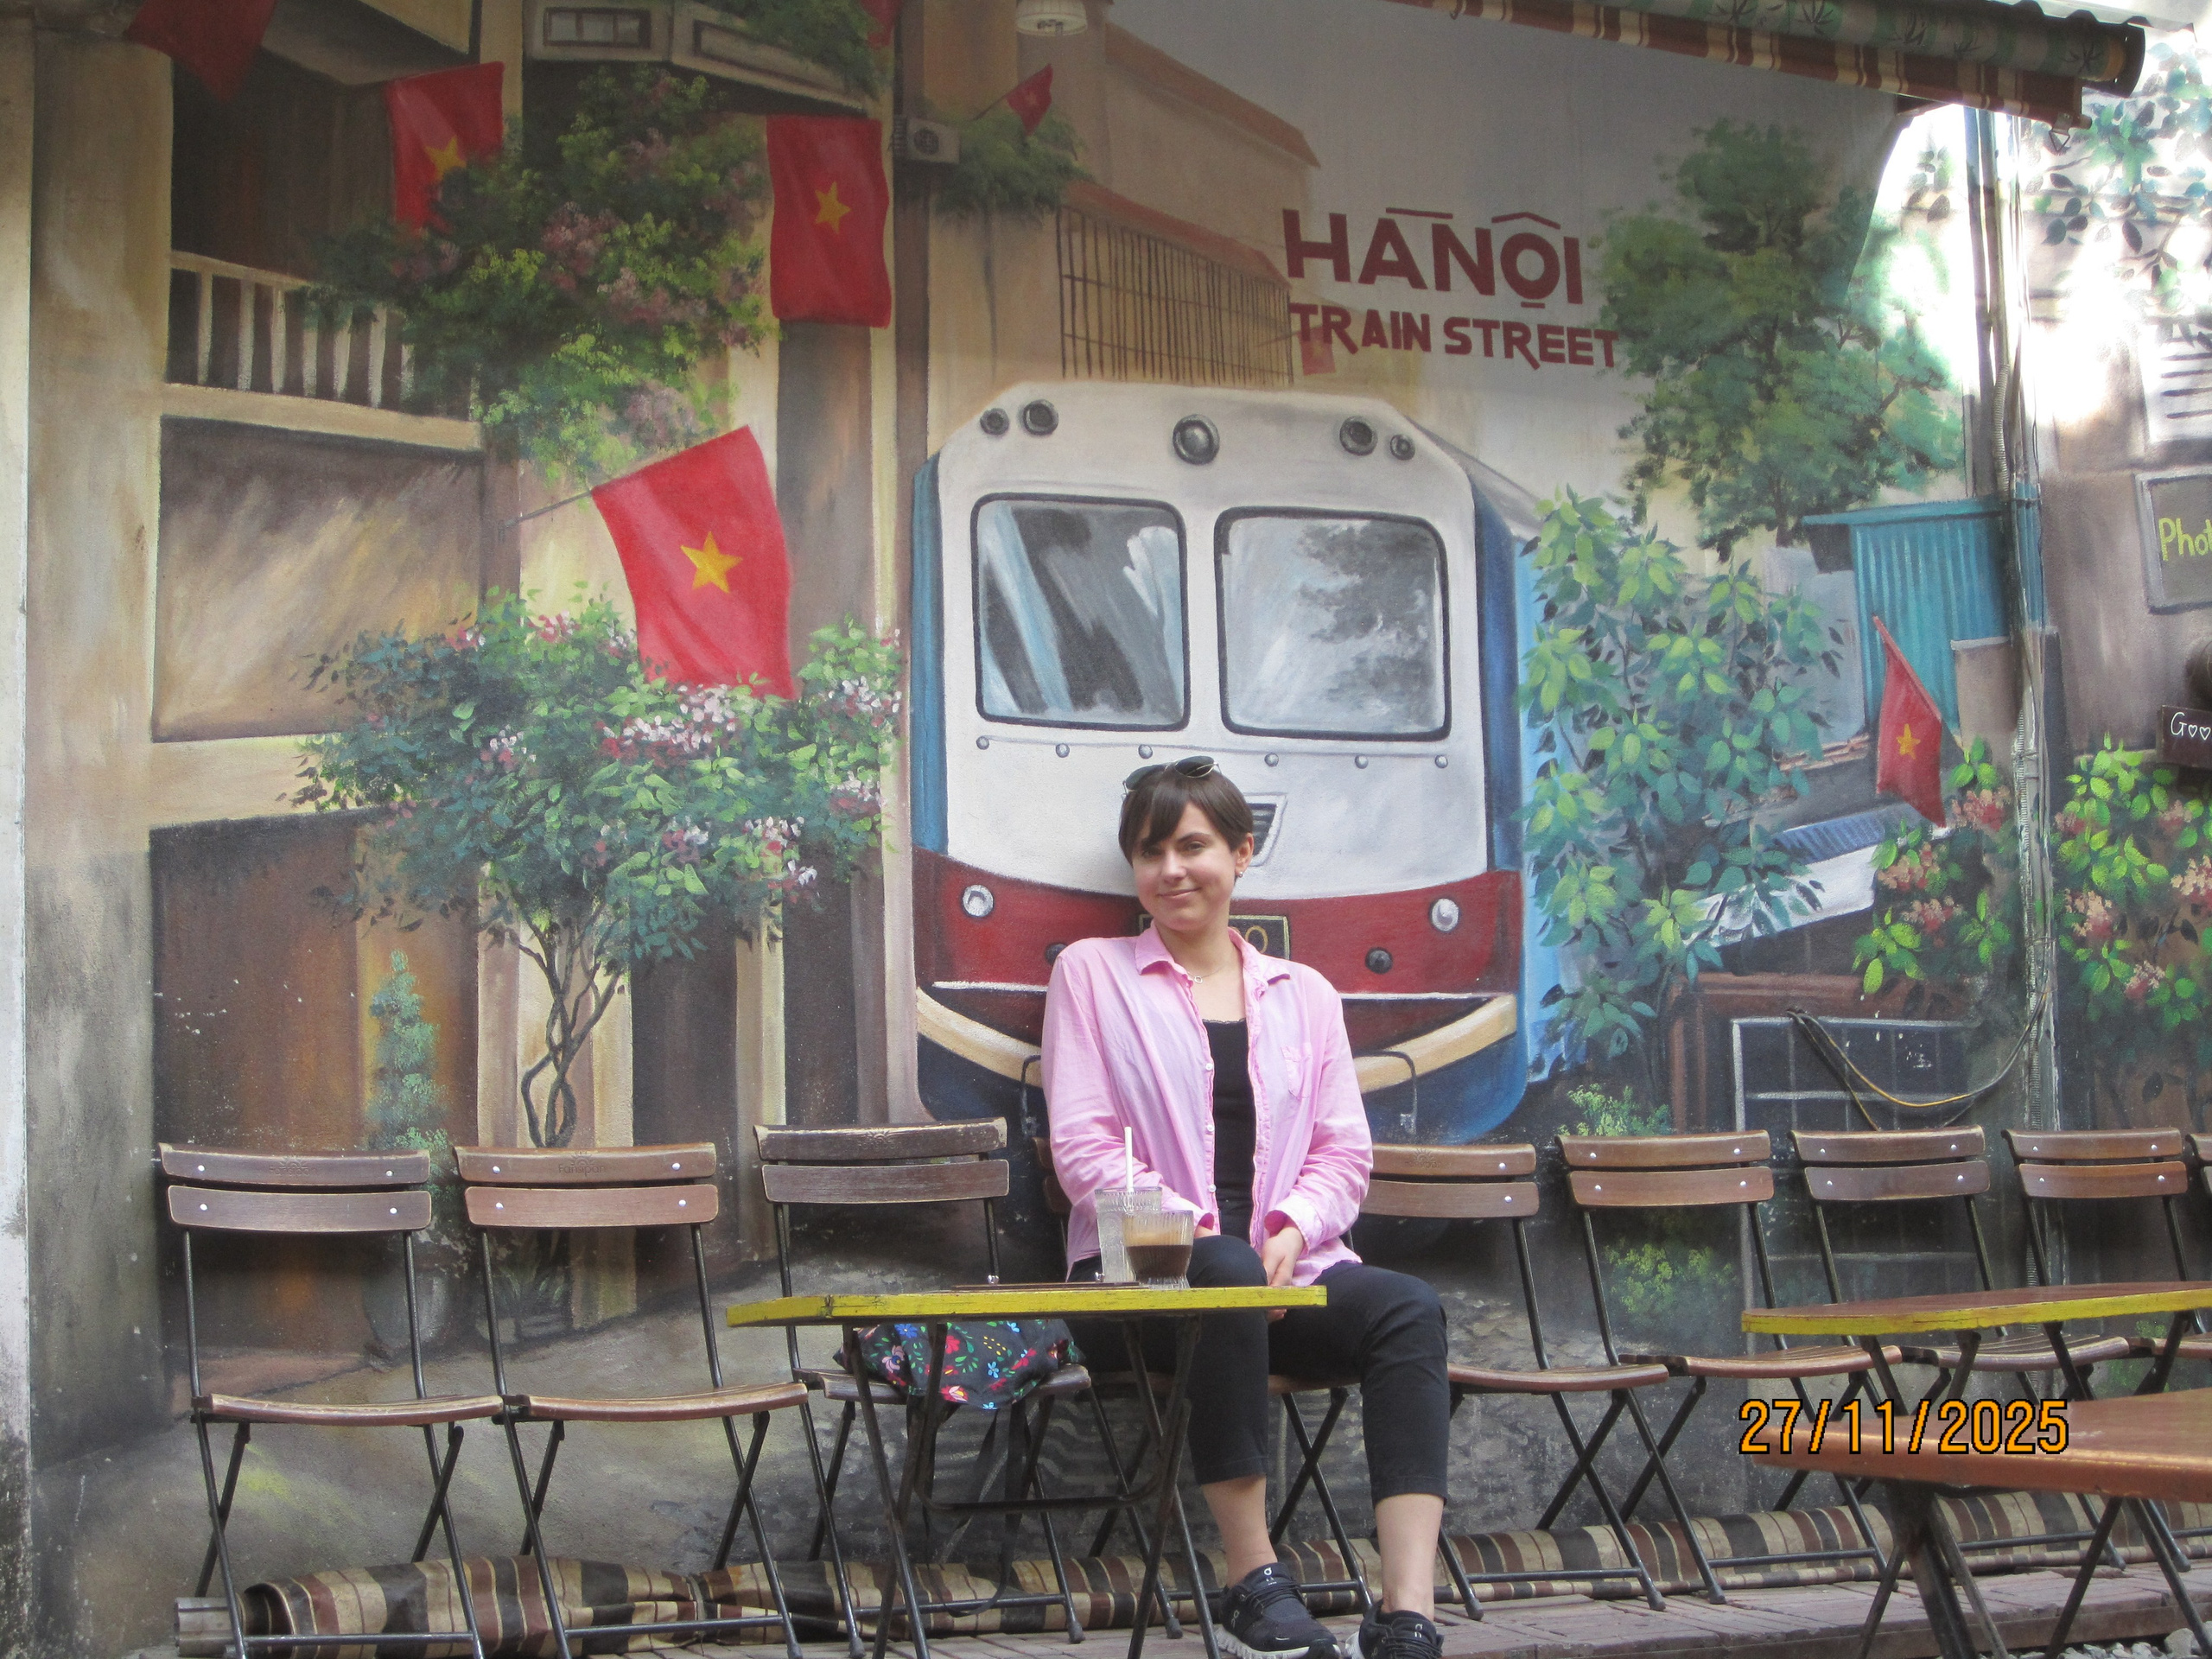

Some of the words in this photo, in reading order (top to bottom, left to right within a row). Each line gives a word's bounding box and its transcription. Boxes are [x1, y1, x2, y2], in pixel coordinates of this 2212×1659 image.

[1289, 302, 1432, 354] TRAIN
[1443, 316, 1619, 370] STREET
[558, 1163, 606, 1177] Fansipan
